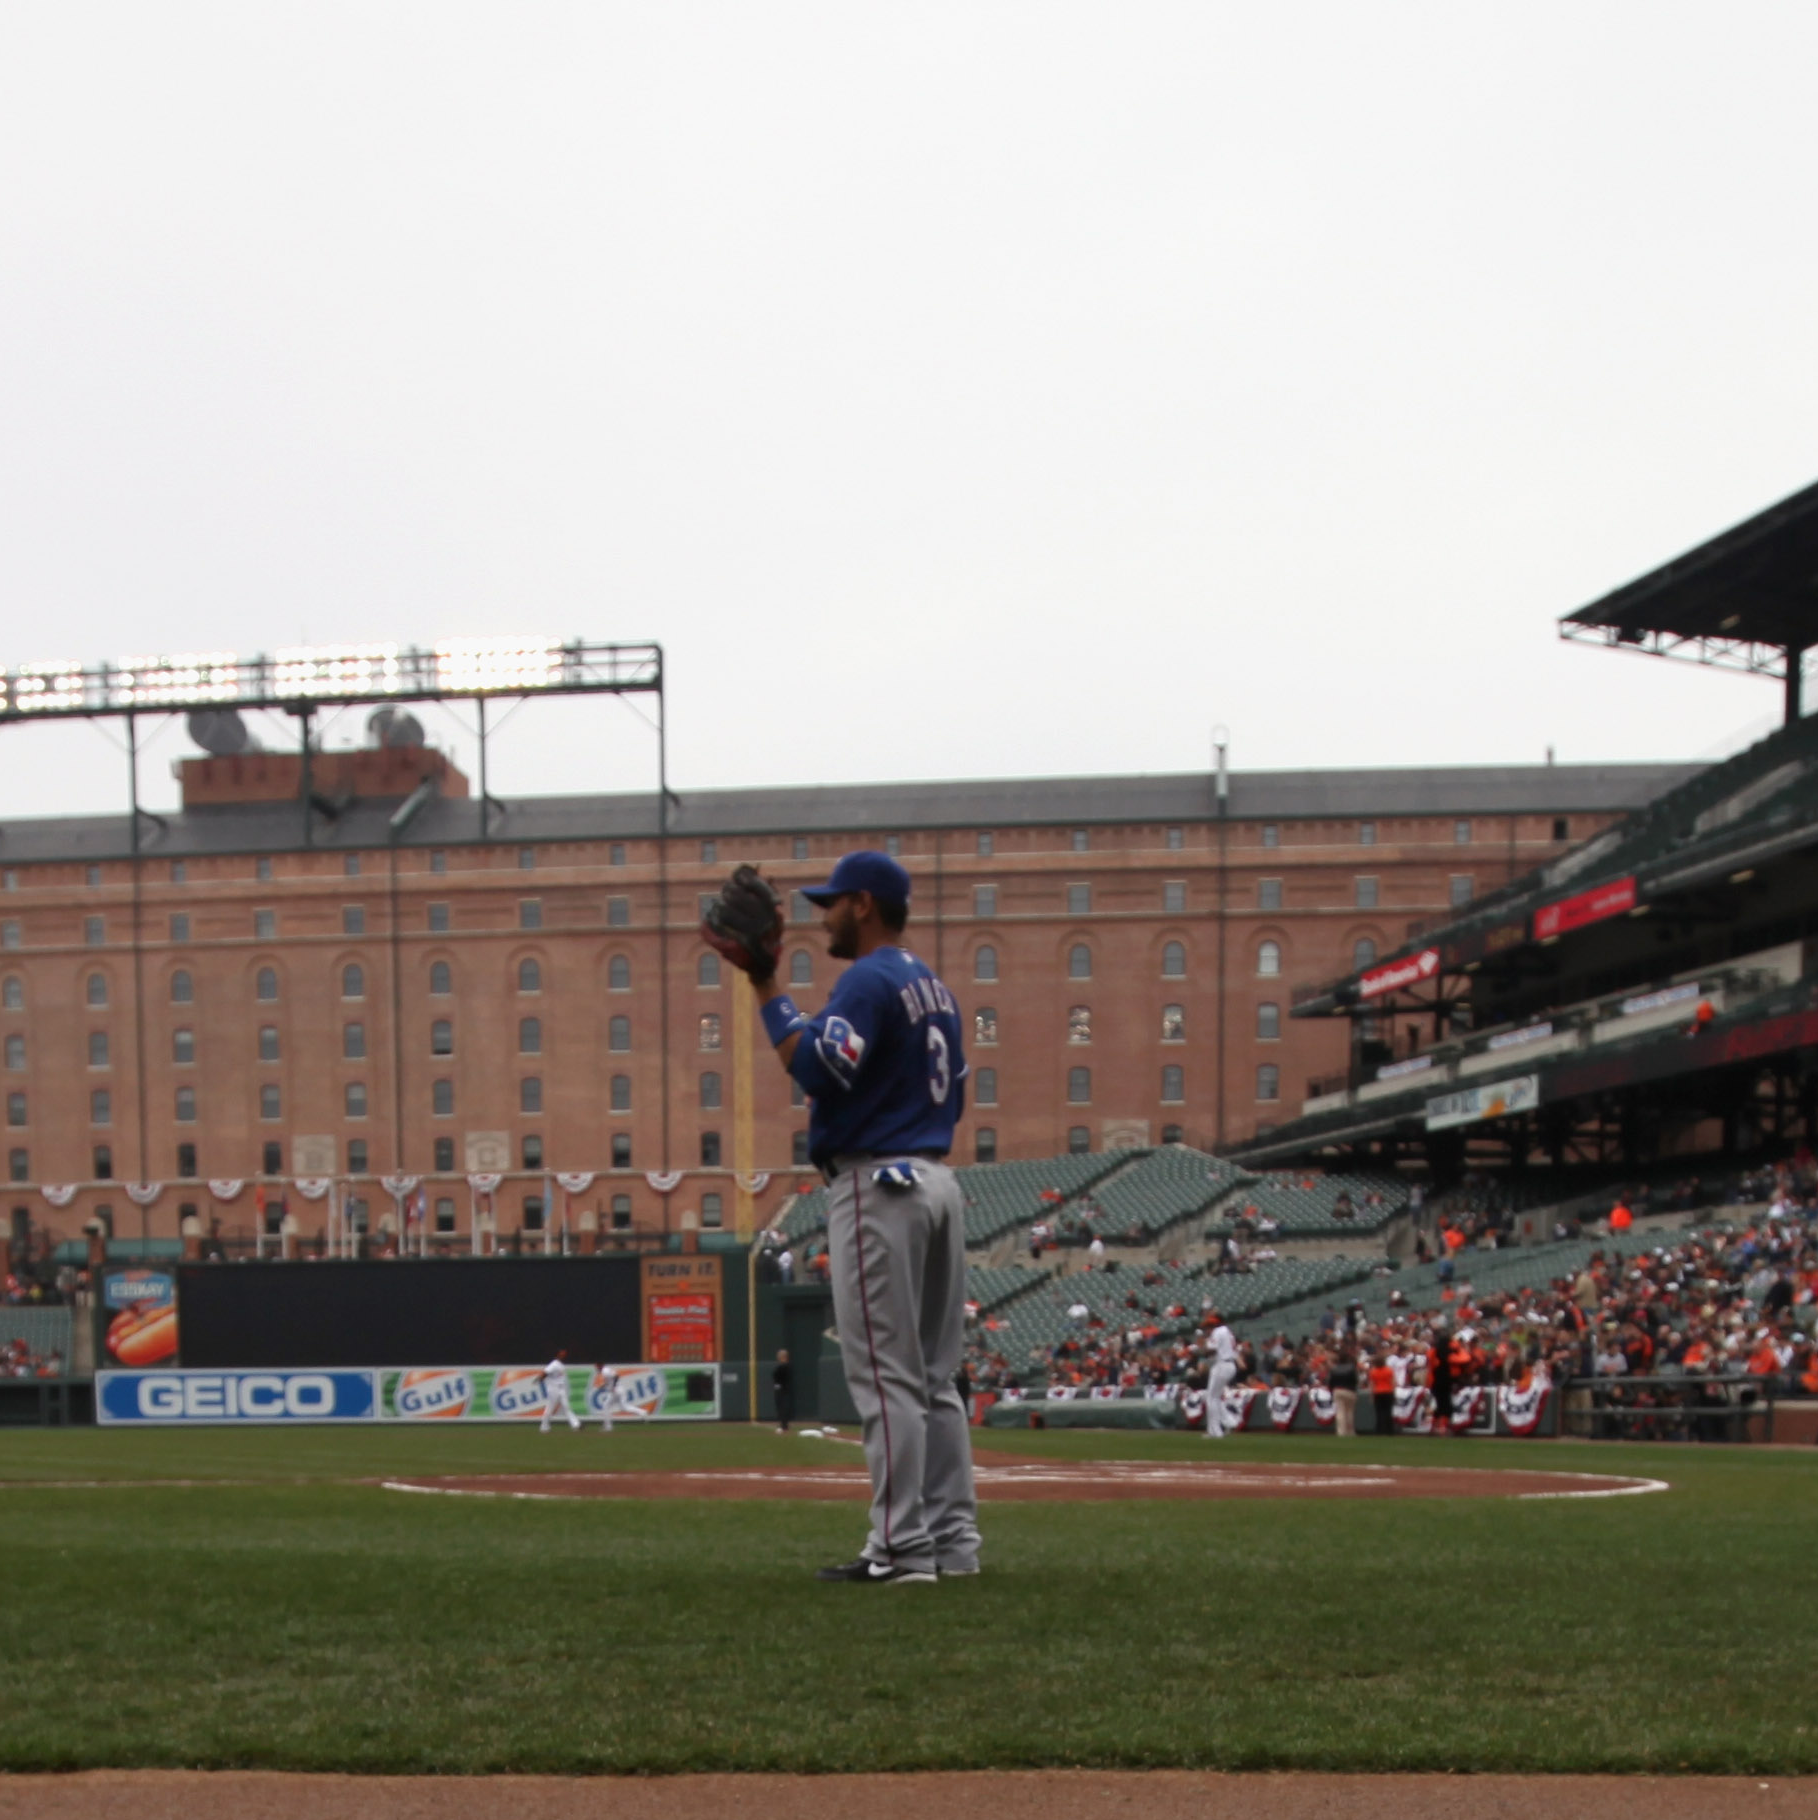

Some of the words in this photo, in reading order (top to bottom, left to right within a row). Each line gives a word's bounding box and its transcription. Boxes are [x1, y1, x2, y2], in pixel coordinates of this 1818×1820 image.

[928, 1025, 950, 1104] 3
[648, 1263, 692, 1277] TURN
[110, 1282, 164, 1298] ESSKAY
[137, 1376, 335, 1417] GEICO
[400, 1376, 468, 1412] Gulf
[496, 1381, 548, 1411] Gul
